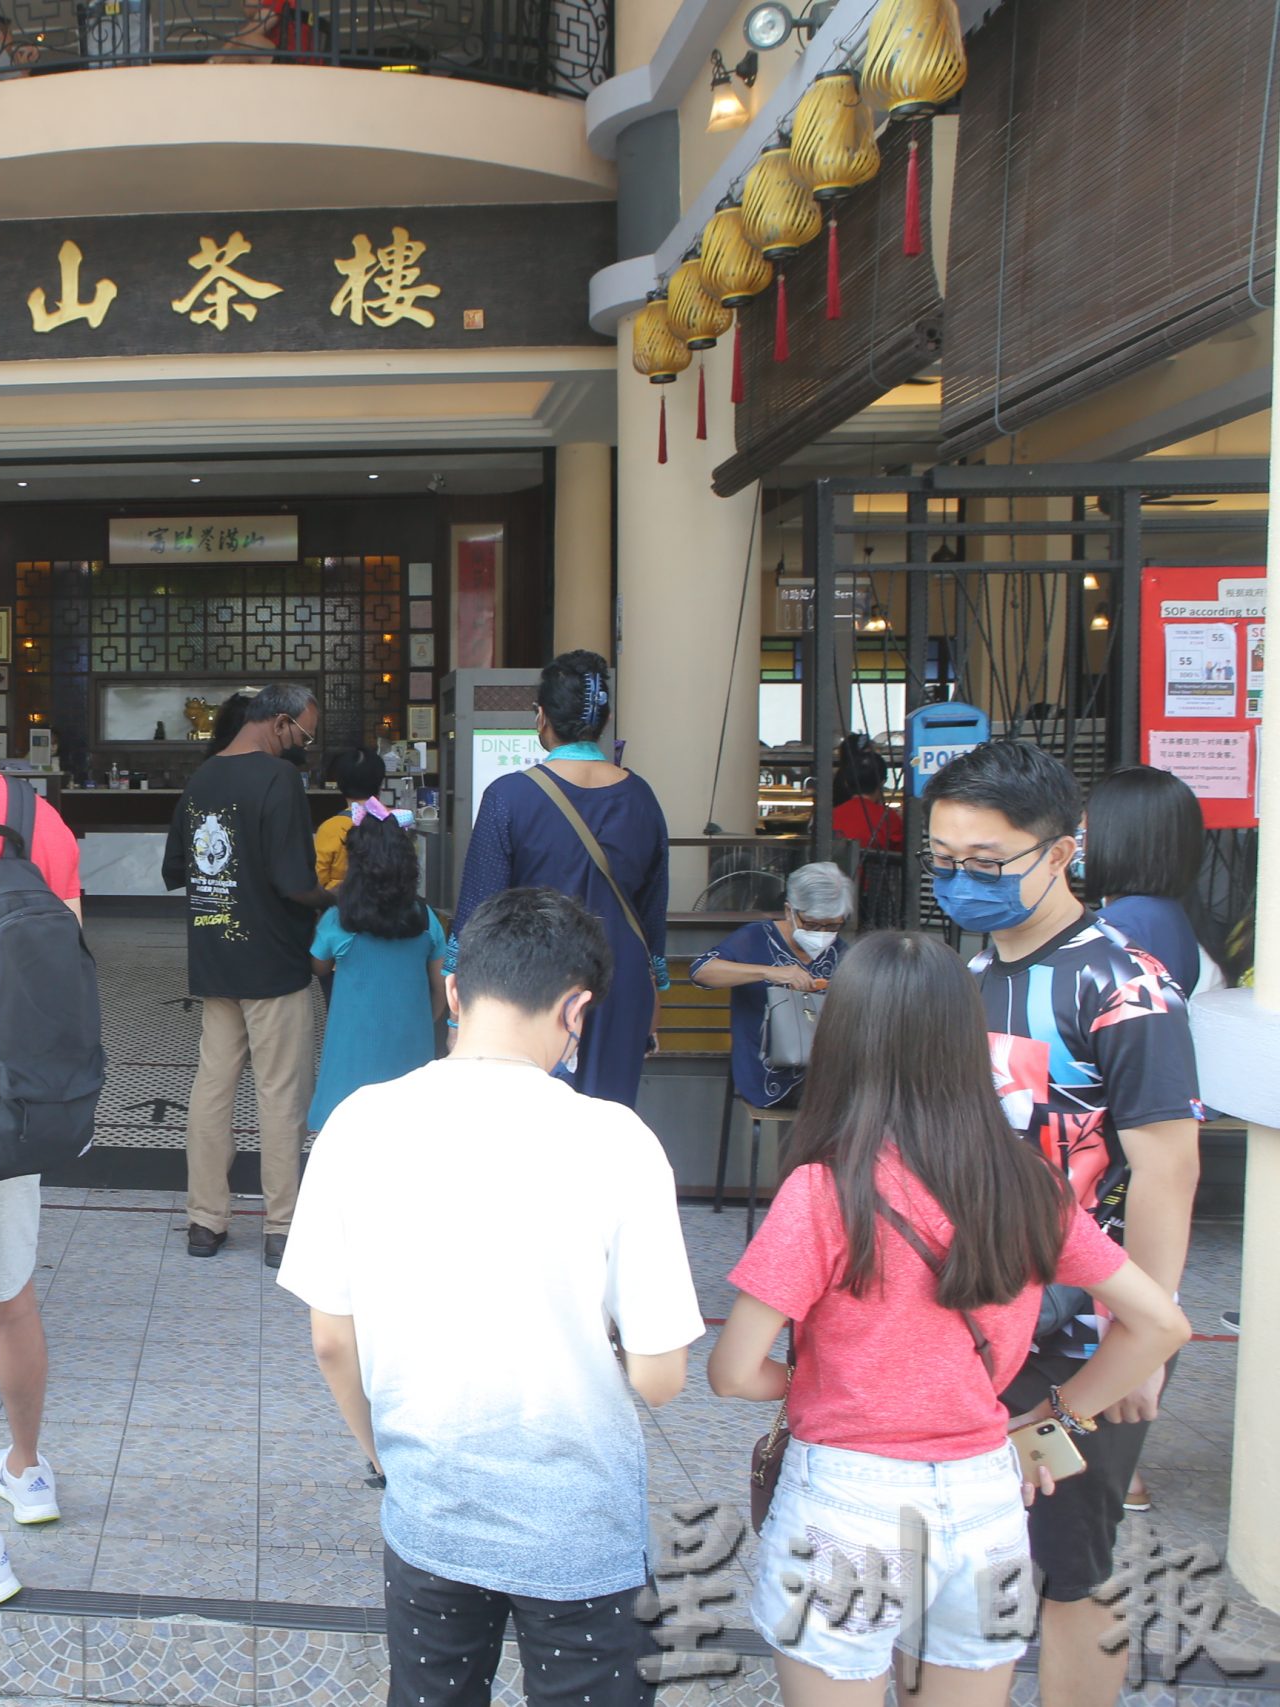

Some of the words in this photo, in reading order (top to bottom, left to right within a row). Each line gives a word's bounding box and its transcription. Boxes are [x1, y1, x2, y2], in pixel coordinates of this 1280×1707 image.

[1163, 606, 1187, 616] SOP
[1188, 606, 1242, 618] according
[1246, 608, 1259, 616] to
[1211, 633, 1225, 642] 55
[1179, 656, 1193, 665] 55
[481, 738, 545, 753] DINE-IN
